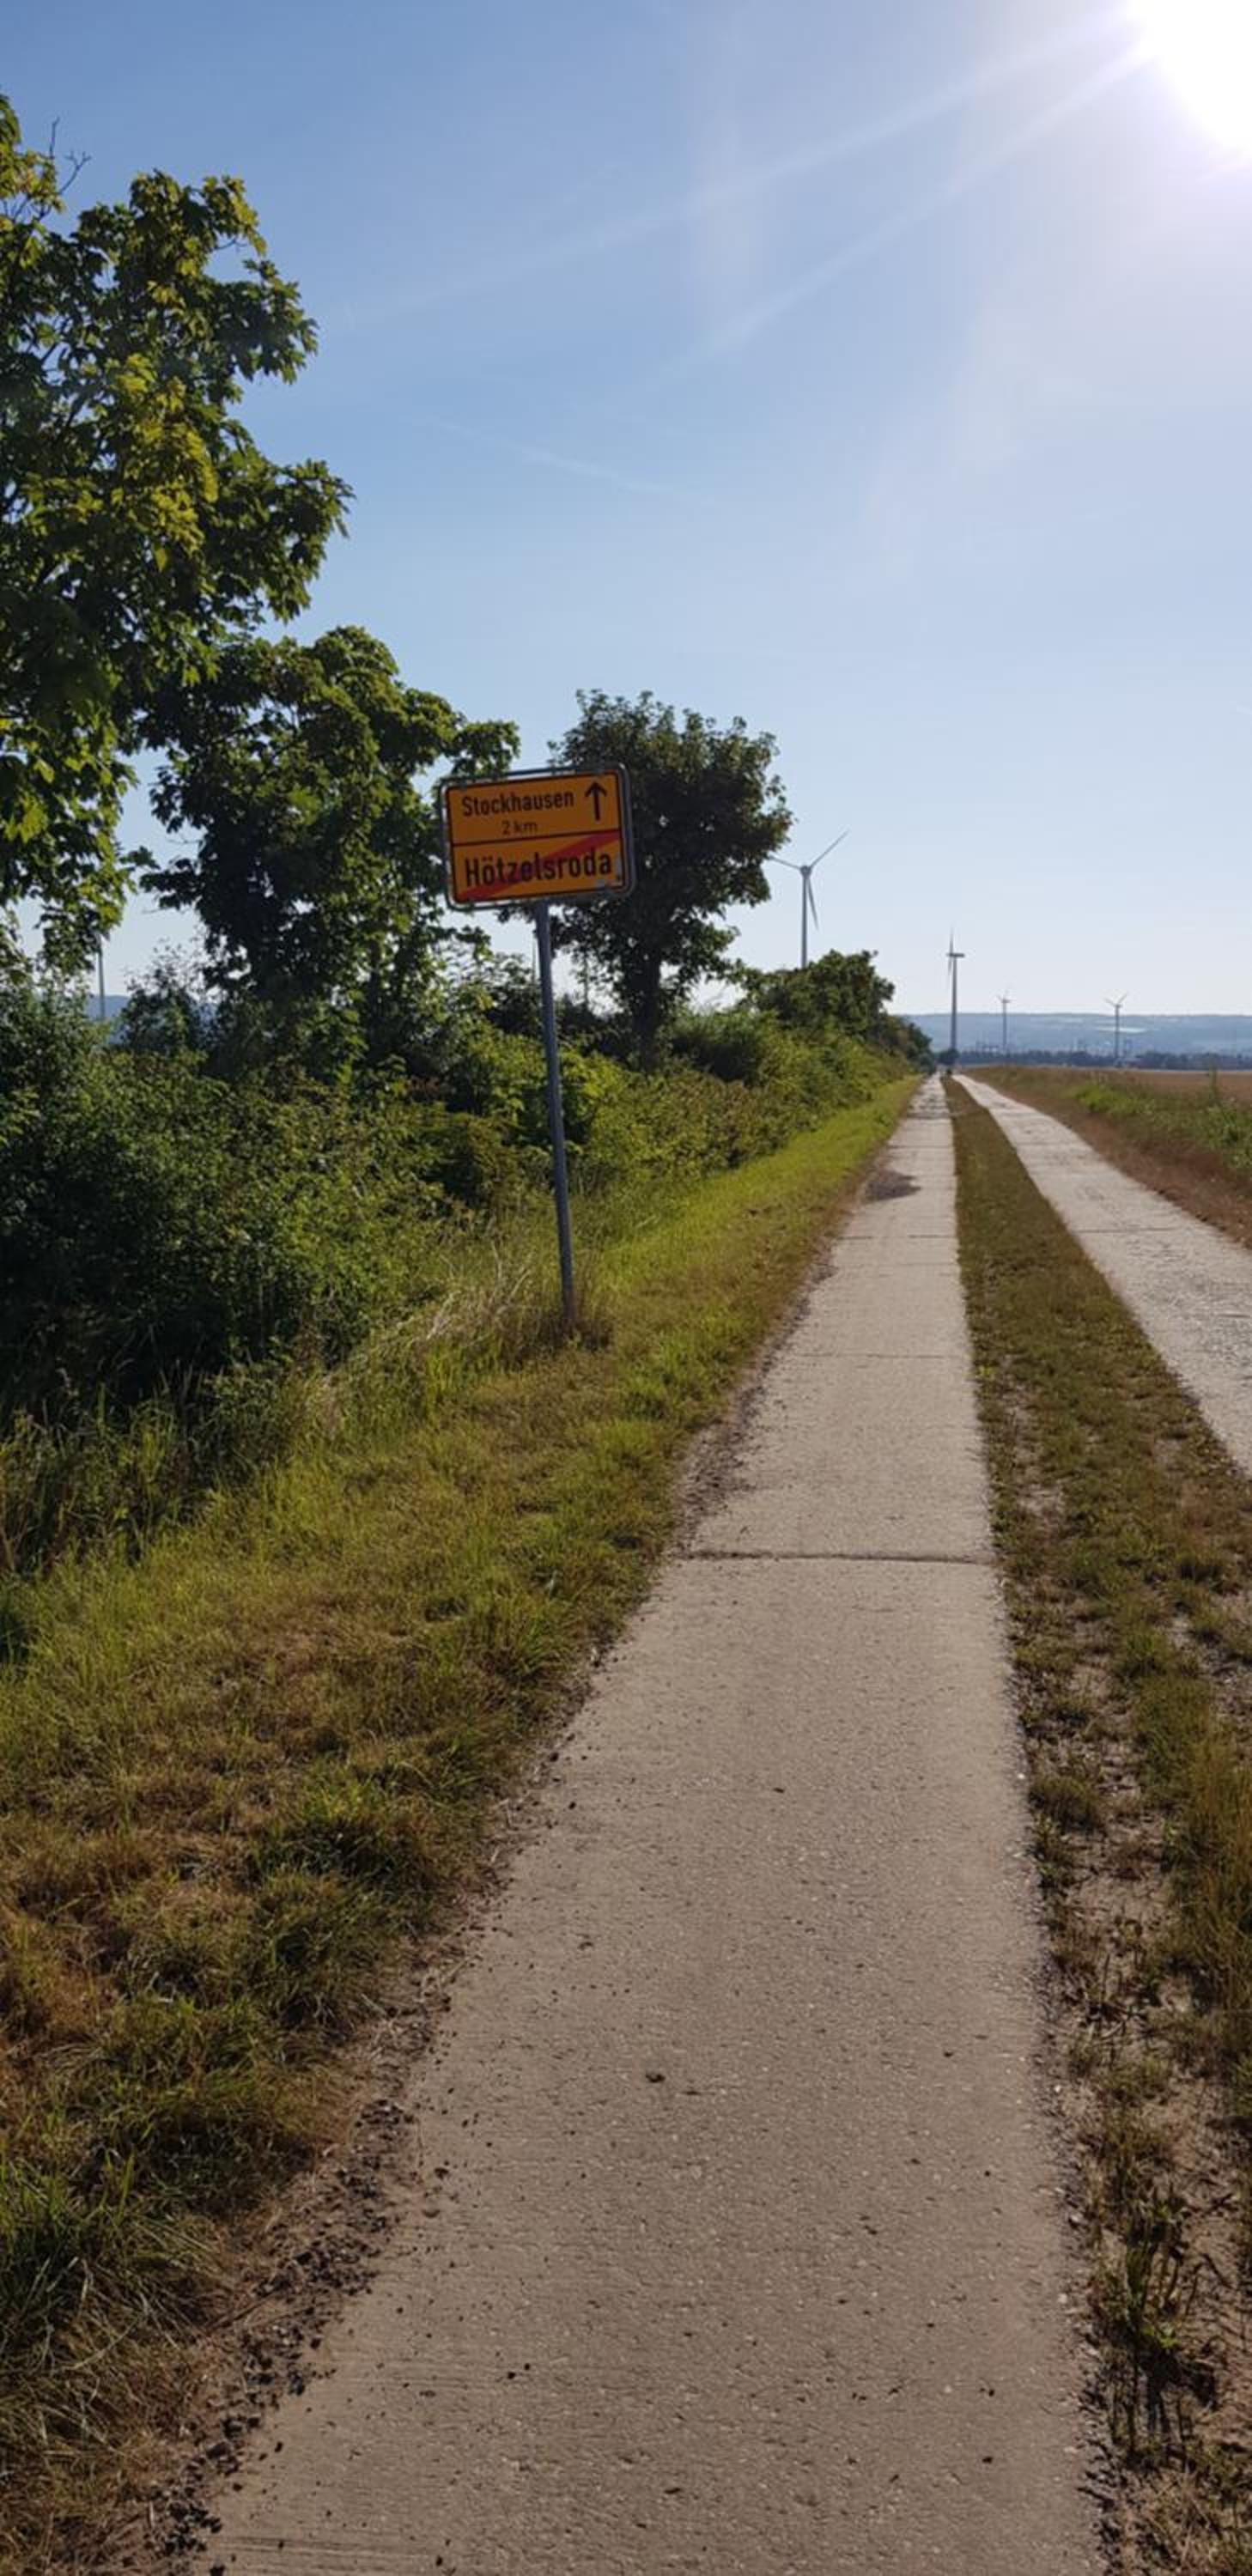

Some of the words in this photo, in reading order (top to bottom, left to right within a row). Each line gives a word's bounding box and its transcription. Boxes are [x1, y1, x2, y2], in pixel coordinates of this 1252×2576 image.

[461, 790, 574, 817] Stockhausen
[501, 821, 511, 835] 2
[515, 820, 538, 833] km
[465, 848, 612, 887] Hötzelsroda
